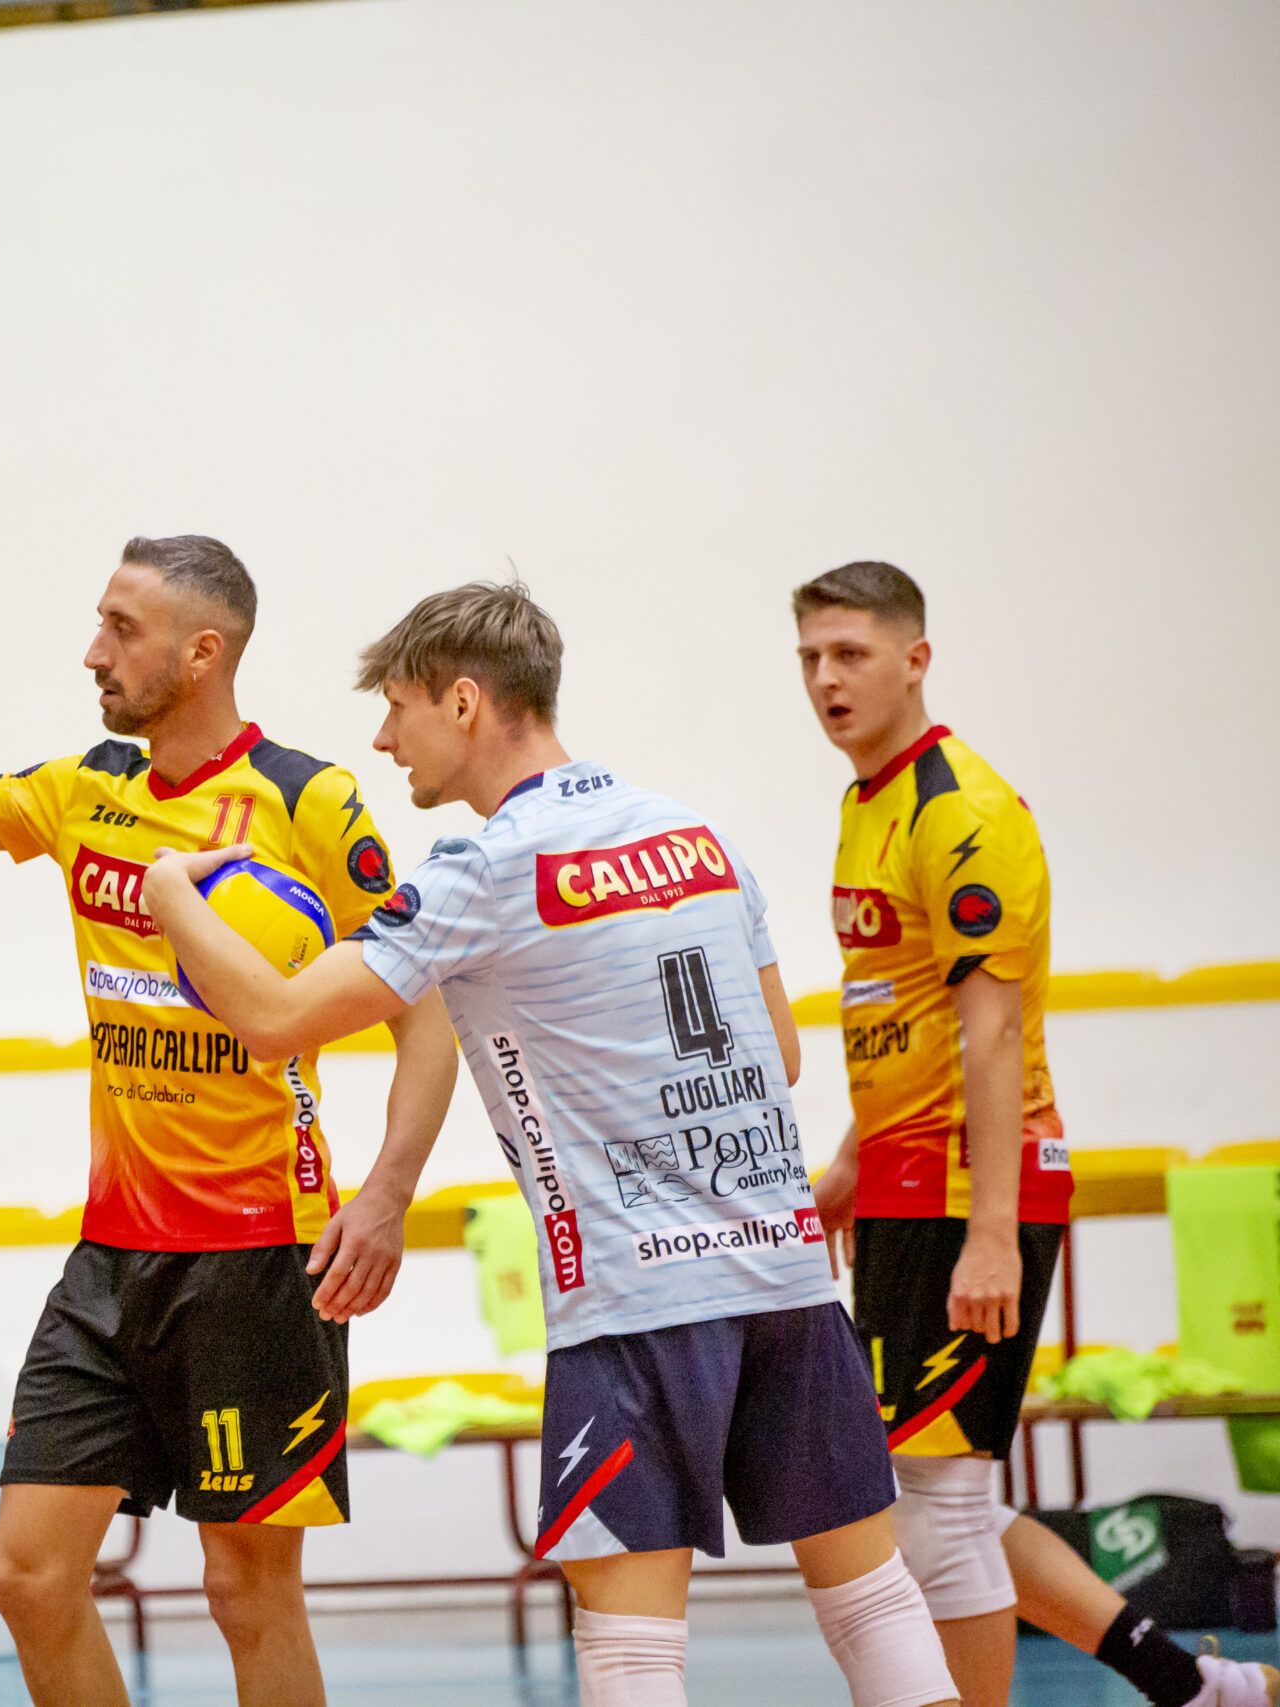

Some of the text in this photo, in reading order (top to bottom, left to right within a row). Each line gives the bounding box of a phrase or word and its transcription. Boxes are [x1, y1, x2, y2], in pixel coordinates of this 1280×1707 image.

[558, 773, 614, 798] Zeus
[90, 804, 140, 828] Zeus
[206, 793, 257, 846] 11
[556, 833, 727, 909] CALLIPO
[640, 886, 685, 906] DAL 1913
[124, 915, 159, 932] DAL 191
[89, 967, 179, 1000] openjobm
[656, 945, 735, 1071] 4
[150, 1028, 249, 1076] CALLIPO
[137, 1085, 196, 1105] Calabria
[659, 1065, 767, 1120] CUGLIARI
[493, 1035, 577, 1286] shop.callipo.com
[201, 1407, 244, 1473] 11
[199, 1470, 255, 1492] Zeus
